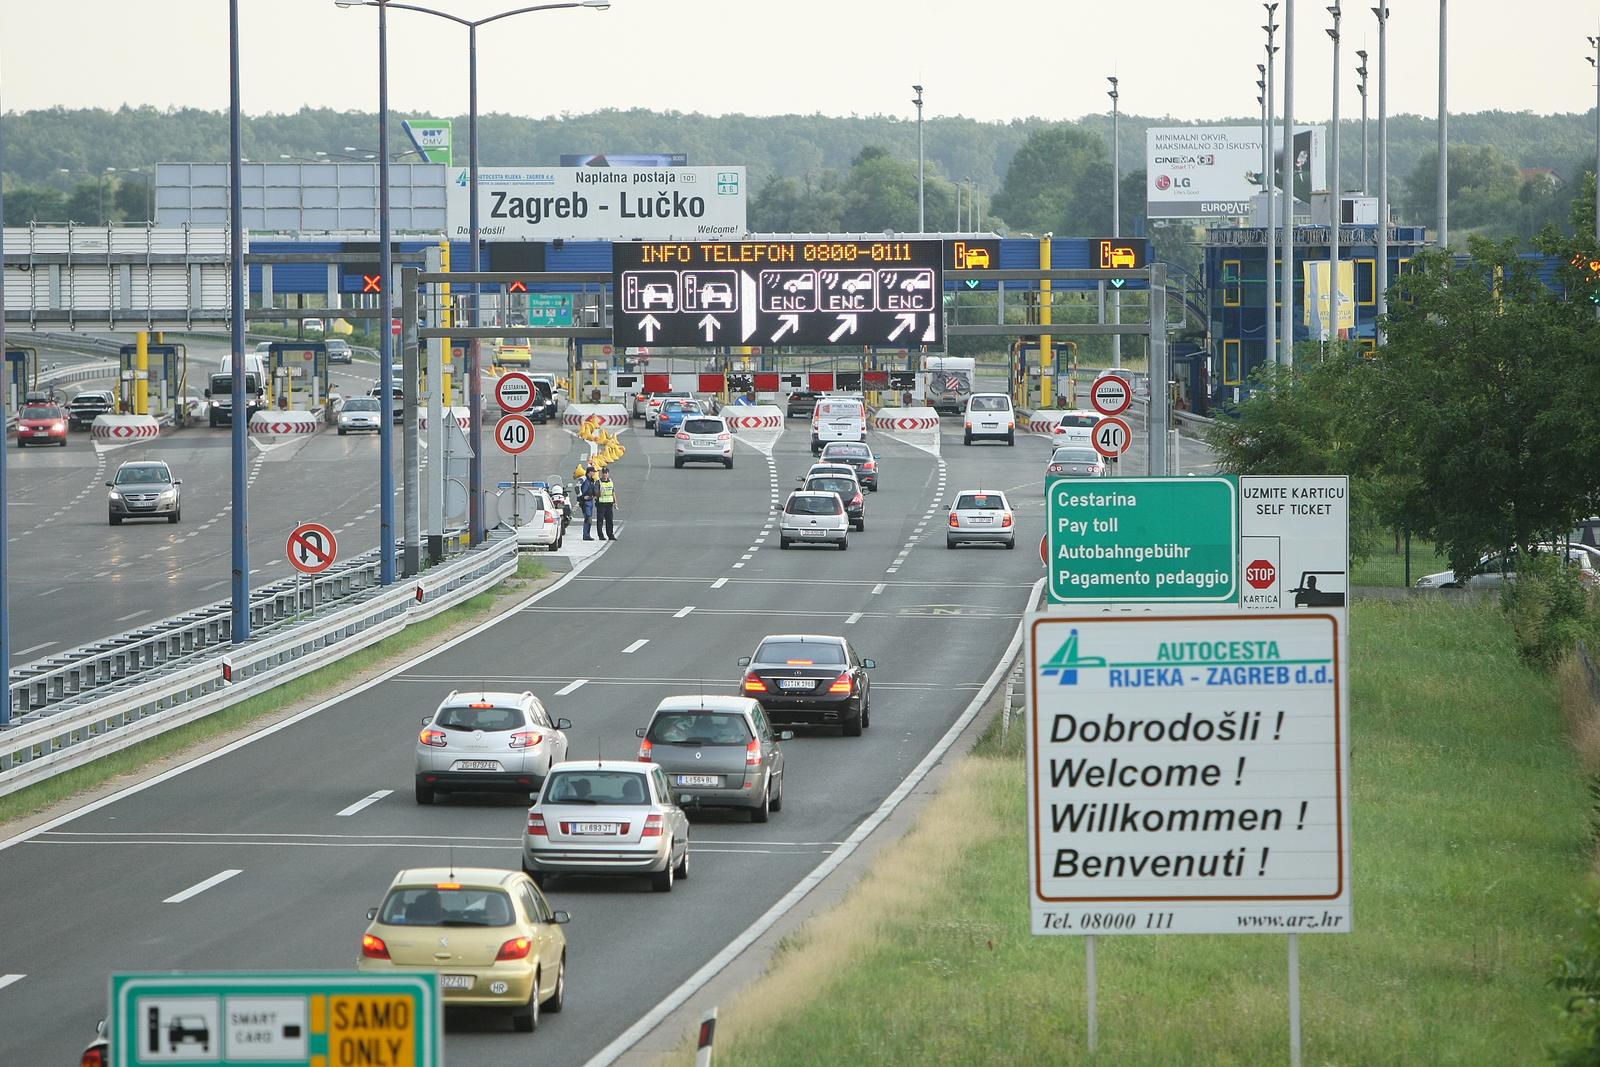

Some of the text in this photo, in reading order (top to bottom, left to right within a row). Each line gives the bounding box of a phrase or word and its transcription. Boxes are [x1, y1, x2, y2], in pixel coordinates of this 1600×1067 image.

[423, 138, 443, 146] OMV
[1155, 134, 1229, 143] MINIMALNI OKVIR,
[1155, 143, 1211, 151] MAKSIMALNO
[1213, 143, 1225, 151] 3D
[1155, 154, 1195, 163] CINEMA
[576, 171, 695, 184] Naplatna postaja 101
[1174, 178, 1190, 187] LG
[490, 191, 588, 224] Zagreb
[620, 191, 705, 218] Lučko
[697, 225, 739, 234] Welcome!
[642, 244, 912, 262] INFO TELEFON 0800-0111
[772, 297, 806, 310] ENC
[830, 296, 864, 309] ENC
[889, 295, 923, 309] ENC
[504, 425, 525, 443] 40
[1100, 429, 1122, 447] 40
[1058, 492, 1137, 507] Cestarina
[1243, 488, 1344, 499] UZMITE KARTICU
[1256, 504, 1332, 515] SELF TICKET
[1058, 517, 1118, 536] Pay toll
[1058, 544, 1191, 562] Autobahngebühr
[1059, 570, 1229, 588] Pagamento pedaggio
[1247, 568, 1275, 581] STOP
[1244, 596, 1279, 604] KARTICA
[1157, 641, 1280, 661] AUTOCESTA
[1109, 669, 1184, 688] RIJEKA
[1206, 667, 1290, 686] ZAGREB
[1295, 666, 1334, 684] d.d.
[1050, 711, 1284, 743] Dobrodošli !
[1050, 757, 1246, 788] Welcome !
[1051, 801, 1308, 833] Willkommen !
[1052, 847, 1269, 878] Benvenuti !
[1042, 913, 1072, 929] Tel.
[1080, 913, 1136, 929] 08000
[1237, 912, 1343, 928] www.arz.hr
[493, 984, 506, 993] HR
[231, 1013, 277, 1026] SMART
[335, 1001, 410, 1030] SAMO
[340, 1037, 402, 1067] ONLY
